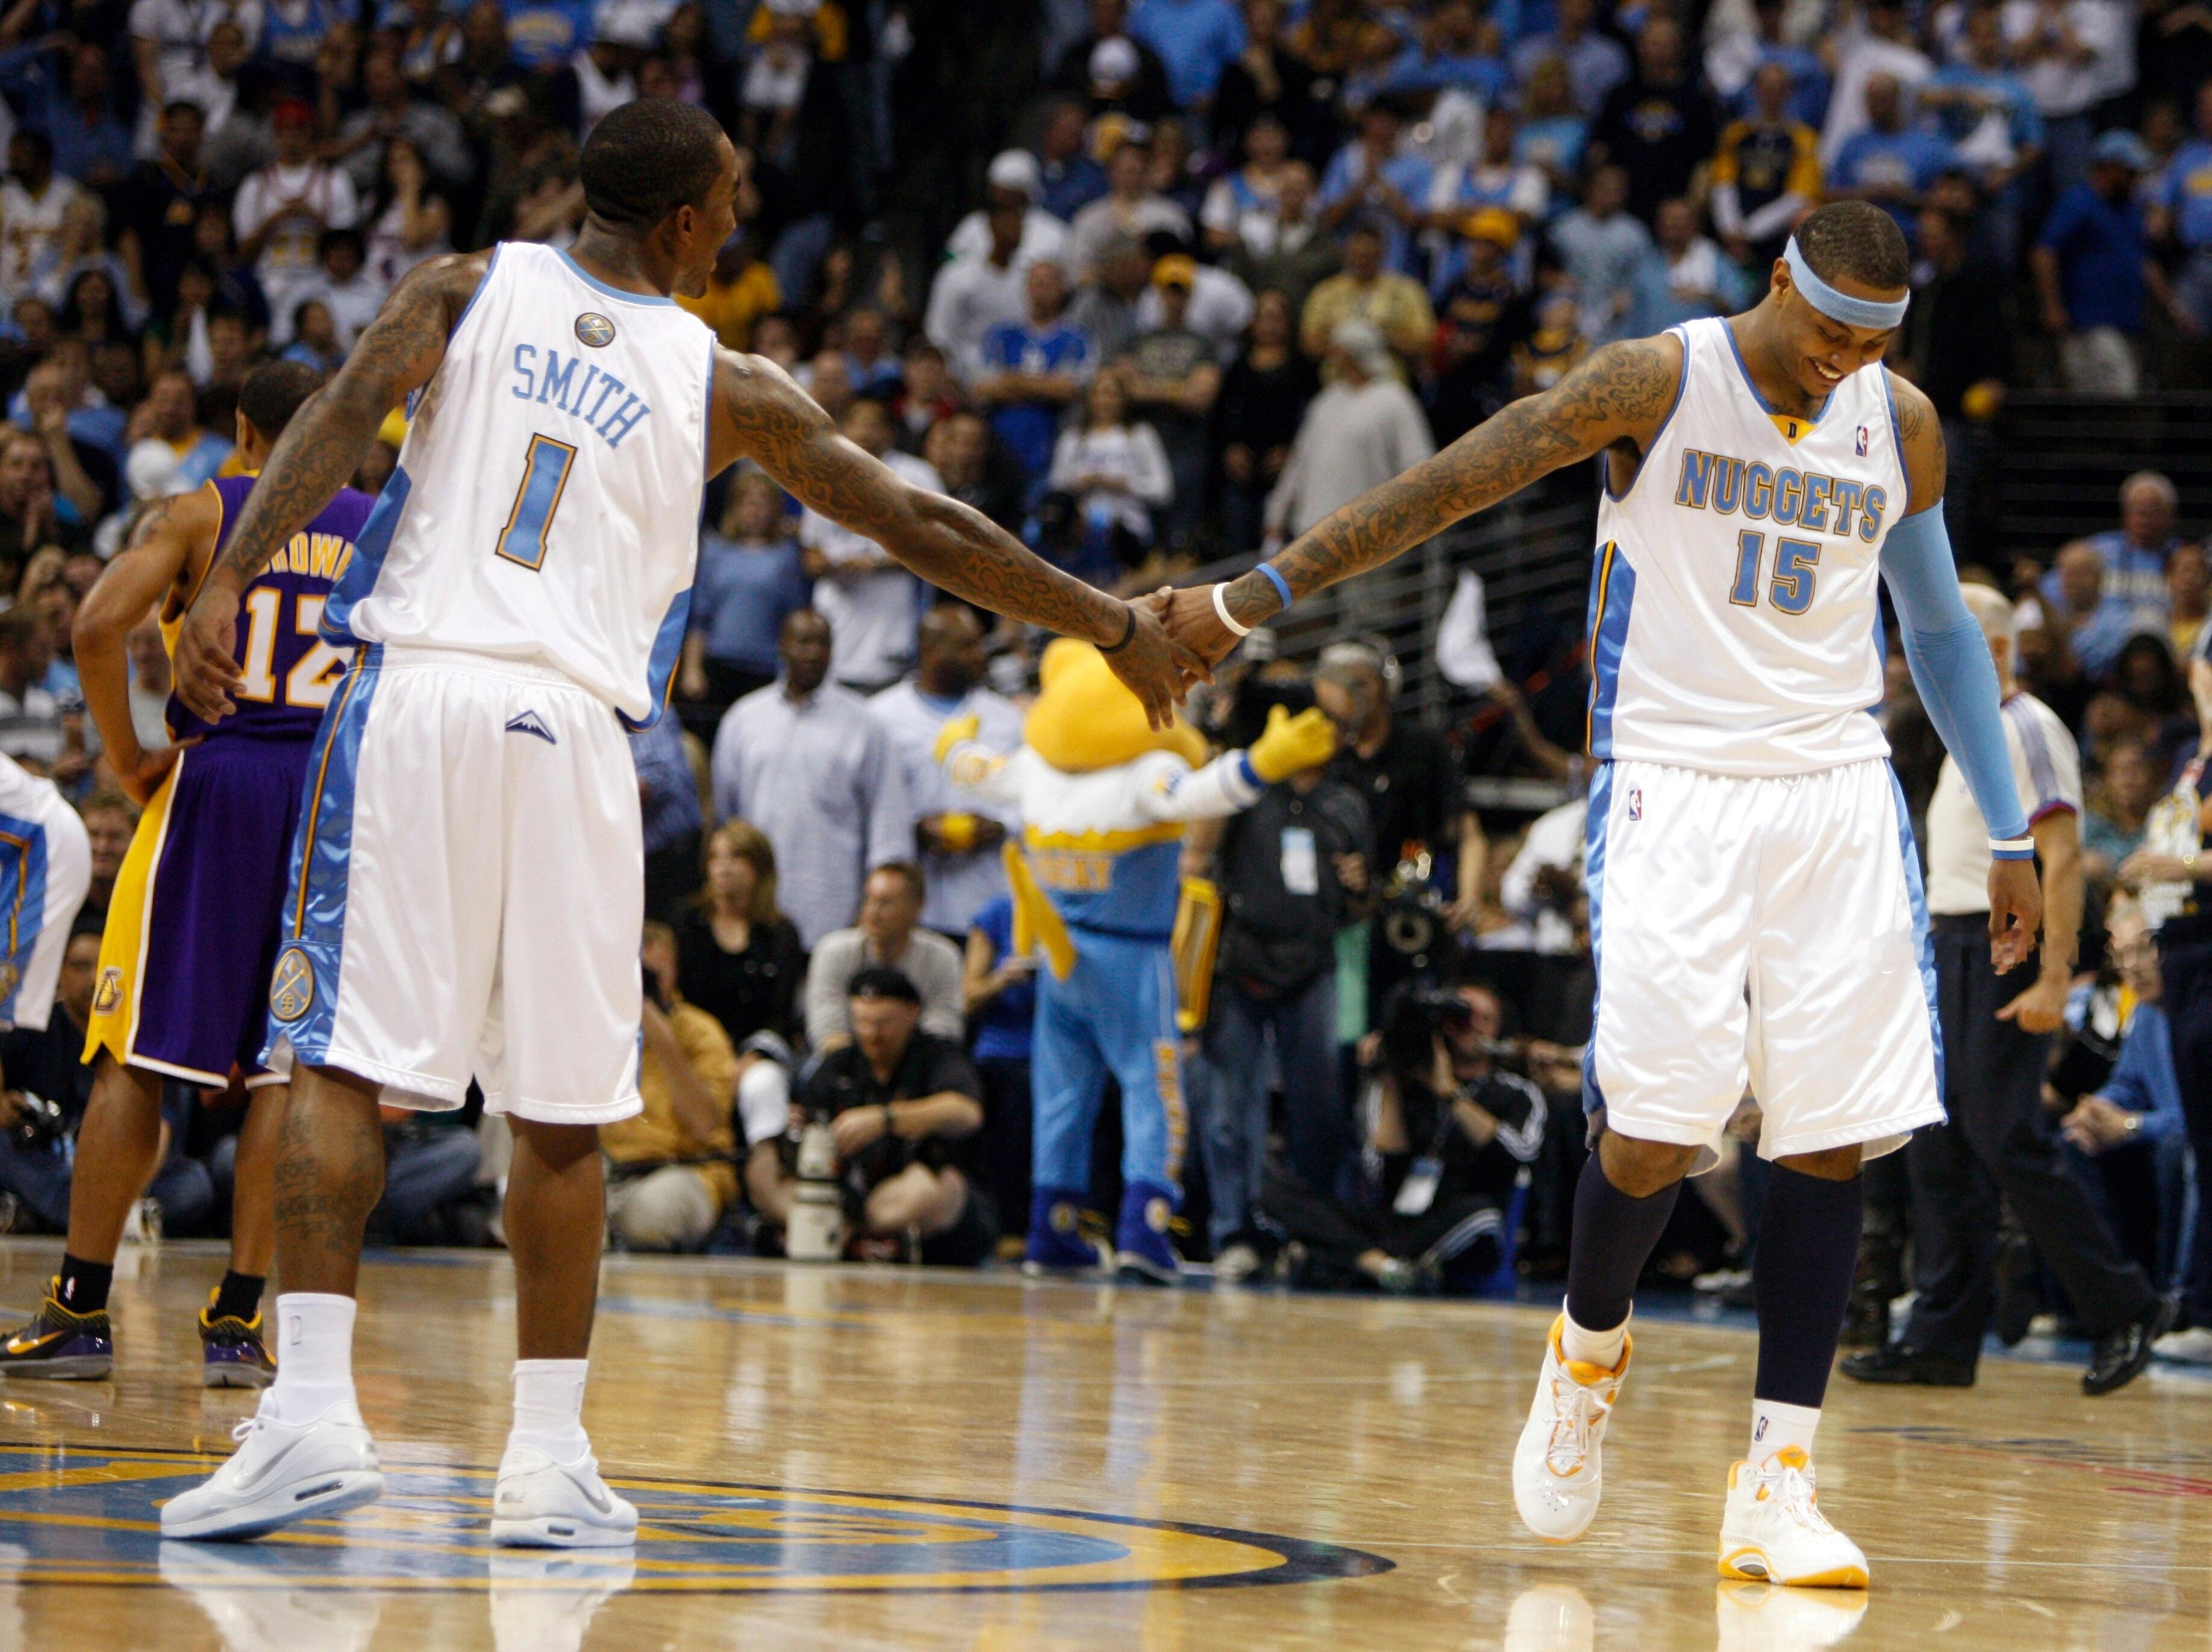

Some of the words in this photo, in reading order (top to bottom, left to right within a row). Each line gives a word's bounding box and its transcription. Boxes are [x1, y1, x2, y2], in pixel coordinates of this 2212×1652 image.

[511, 343, 650, 449] SMITH
[1788, 422, 1797, 438] D
[496, 433, 578, 572] 1
[1675, 449, 1887, 543] NUGGETS
[1730, 530, 1822, 615] 15
[234, 585, 354, 709] 12
